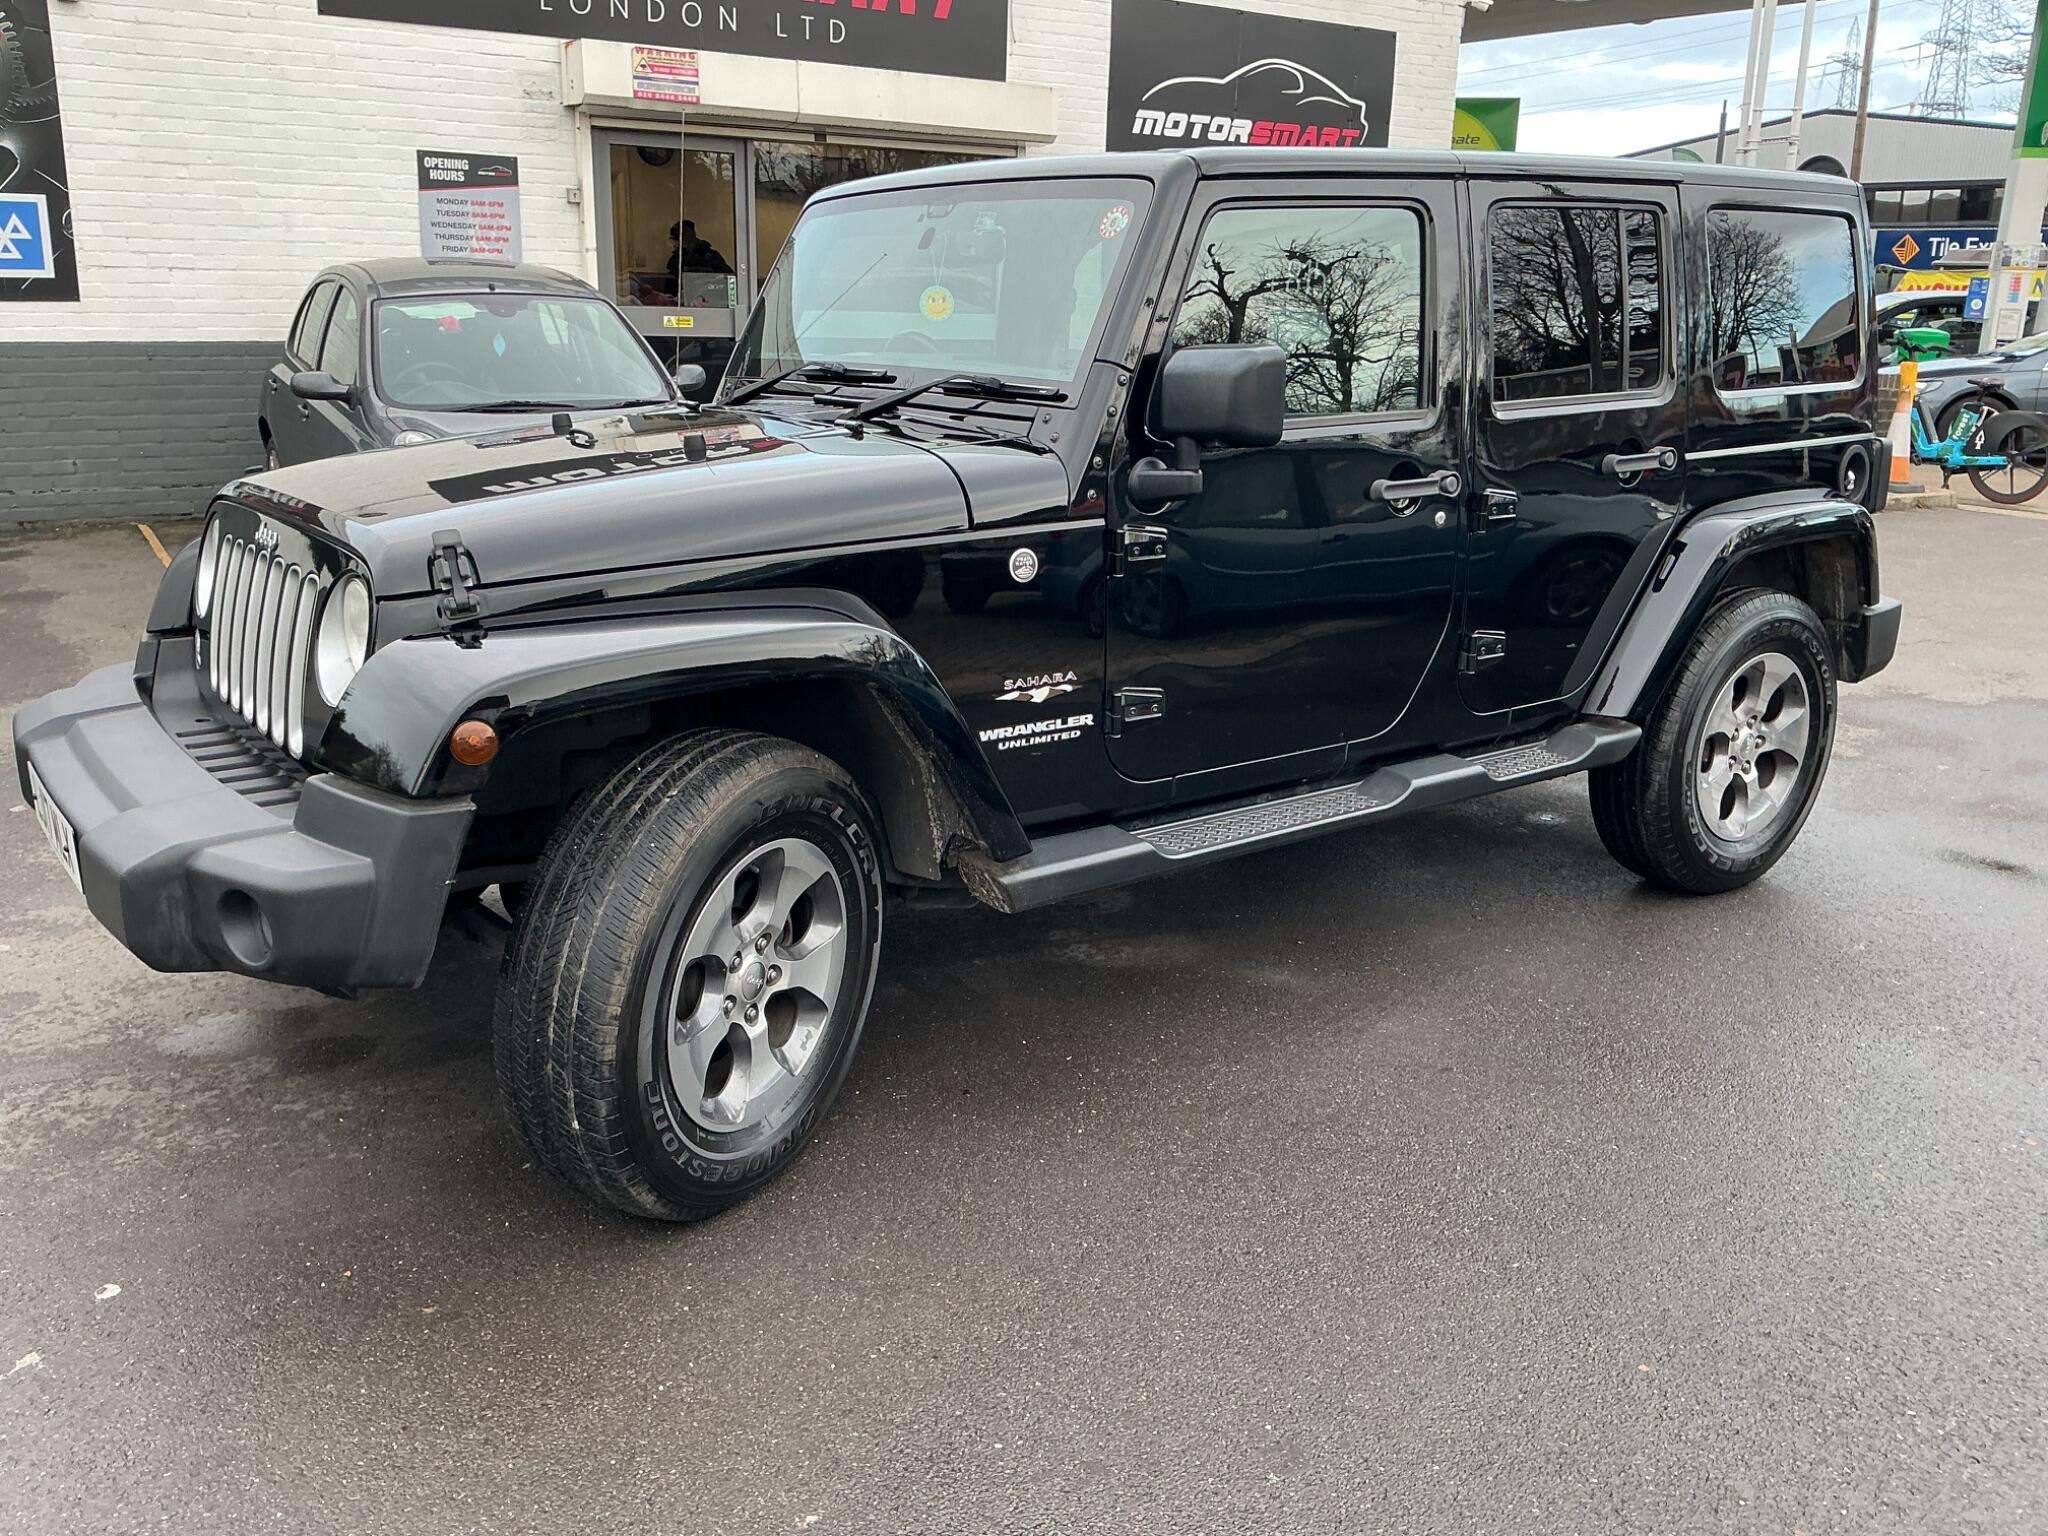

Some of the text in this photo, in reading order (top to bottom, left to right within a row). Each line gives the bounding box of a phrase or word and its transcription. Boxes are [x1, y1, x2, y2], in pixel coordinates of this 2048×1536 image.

[776, 13, 846, 44] LTD
[635, 47, 696, 60] WARNING
[1131, 108, 1361, 148] MOTORSMART
[424, 157, 469, 170] OPENING
[429, 169, 465, 181] HOURS
[436, 198, 469, 206] MONDAY
[436, 210, 470, 218] TUESDAY
[430, 221, 477, 229] WEDNESDAY
[434, 233, 474, 241] THURSDAY
[442, 245, 469, 253] FRIDAY
[1928, 237, 1960, 257] Tile
[1003, 670, 1078, 690] SAHARA
[979, 713, 1095, 742] WRANGLER
[998, 730, 1082, 751] UNLIMITED
